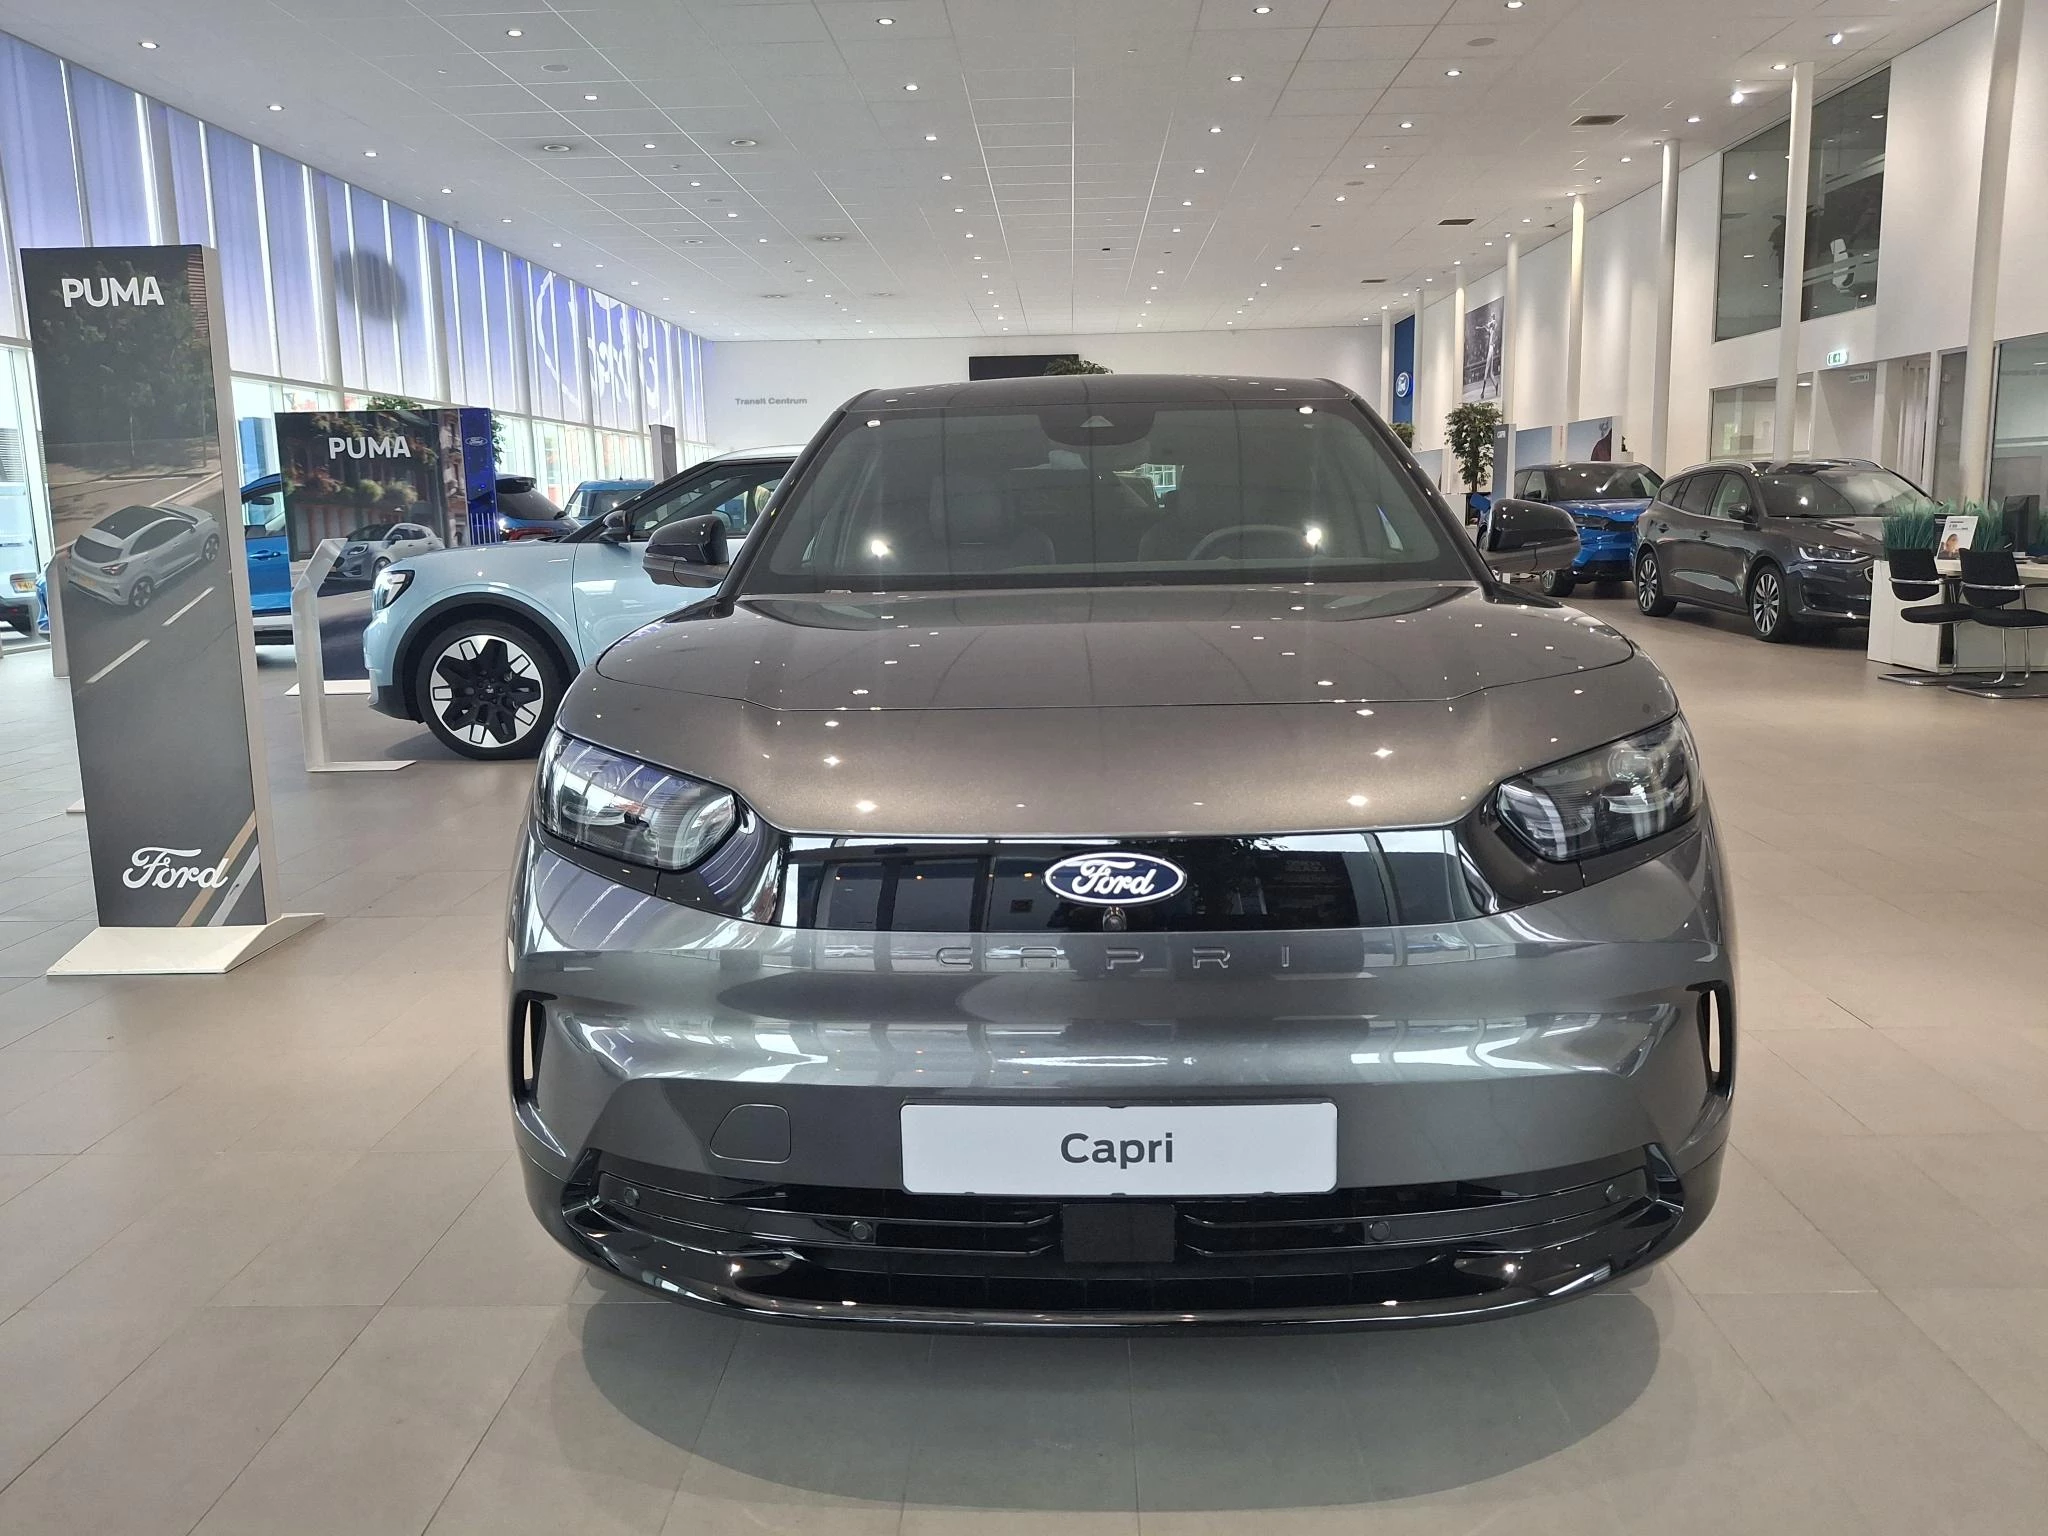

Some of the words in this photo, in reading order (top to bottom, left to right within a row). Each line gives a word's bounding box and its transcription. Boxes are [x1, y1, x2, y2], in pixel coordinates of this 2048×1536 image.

[61, 276, 165, 308] PUMA
[735, 398, 767, 406] Transit
[768, 397, 808, 405] Centrum
[328, 435, 412, 460] PUMA
[122, 846, 229, 889] Ford
[1070, 858, 1157, 896] Ford
[935, 946, 1291, 971] CAPRI
[1060, 1132, 1173, 1170] Capri
